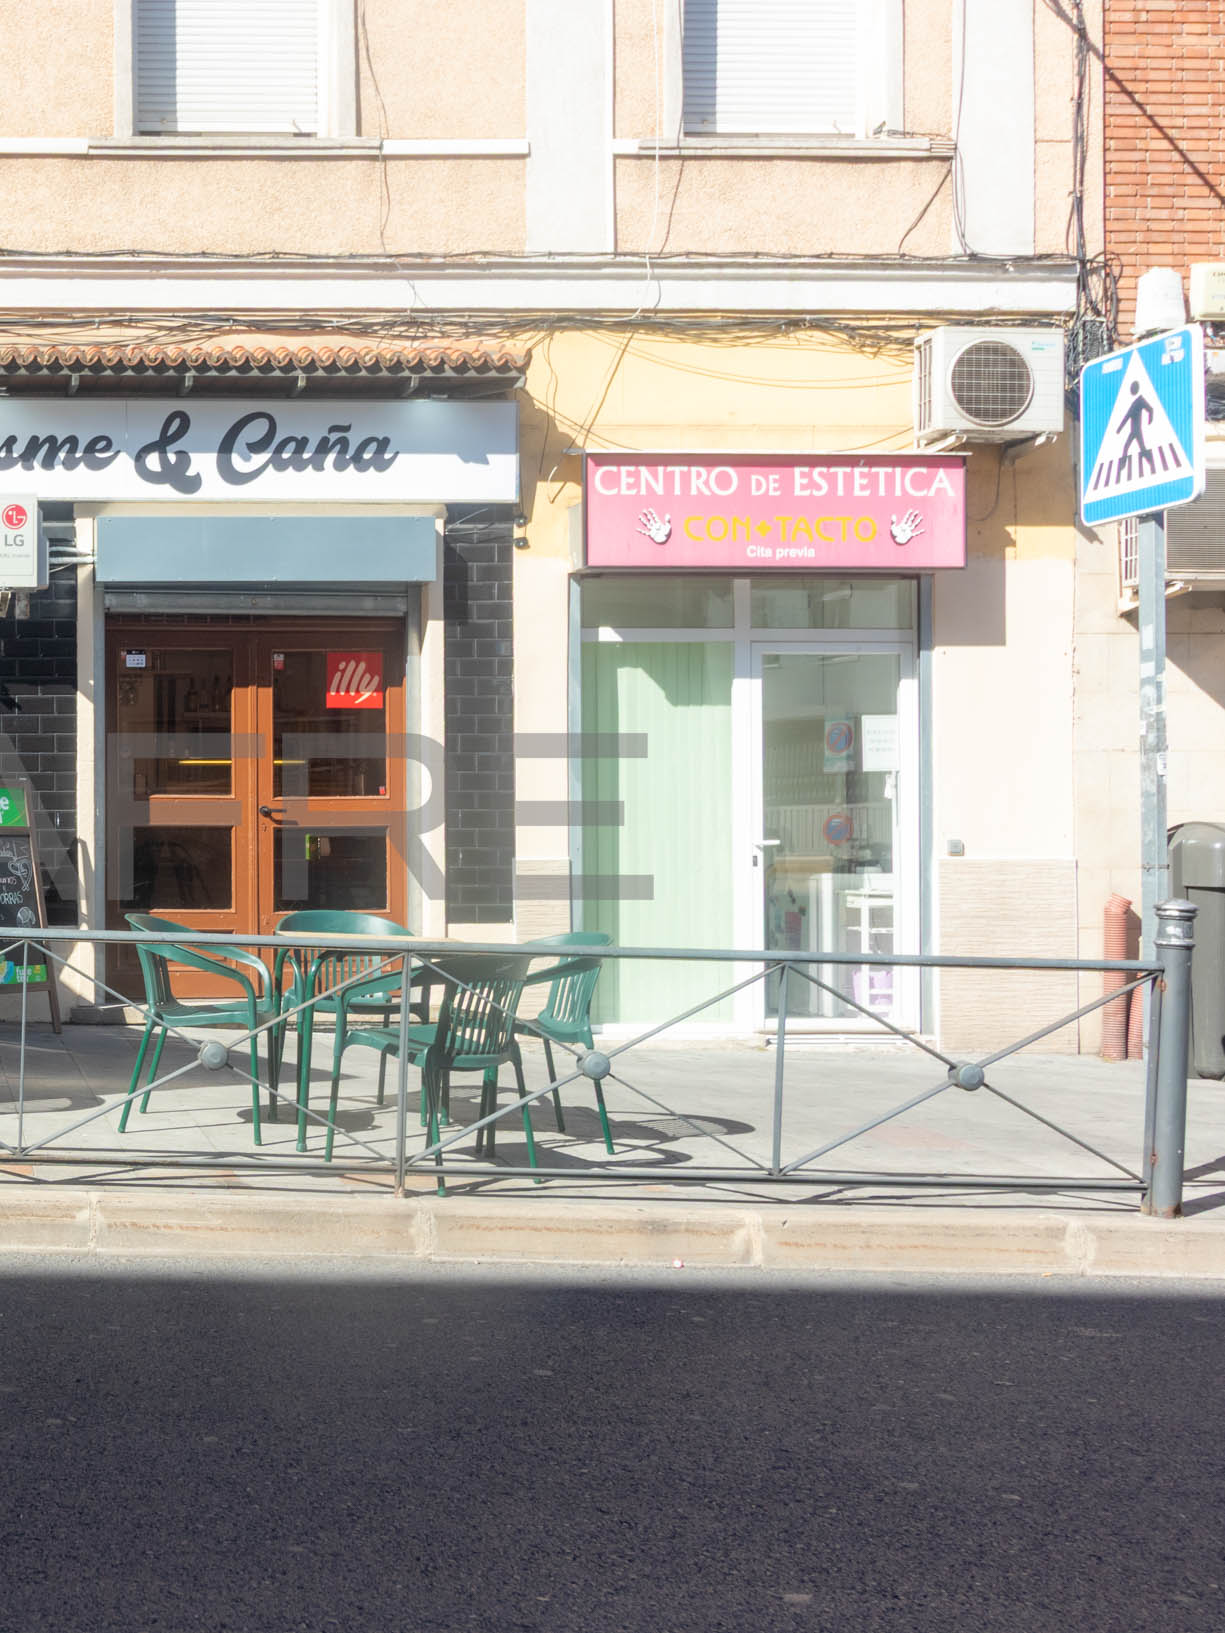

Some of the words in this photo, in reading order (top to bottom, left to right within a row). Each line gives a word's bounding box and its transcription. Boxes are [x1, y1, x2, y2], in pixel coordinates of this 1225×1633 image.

[134, 410, 203, 495] &
[216, 411, 400, 486] Caña
[594, 466, 739, 497] CENTRO
[751, 475, 781, 496] DE
[793, 459, 956, 497] ESTÉTICA
[4, 534, 25, 547] LG
[747, 545, 773, 559] Cita
[776, 545, 816, 561] previa
[329, 660, 380, 704] illy
